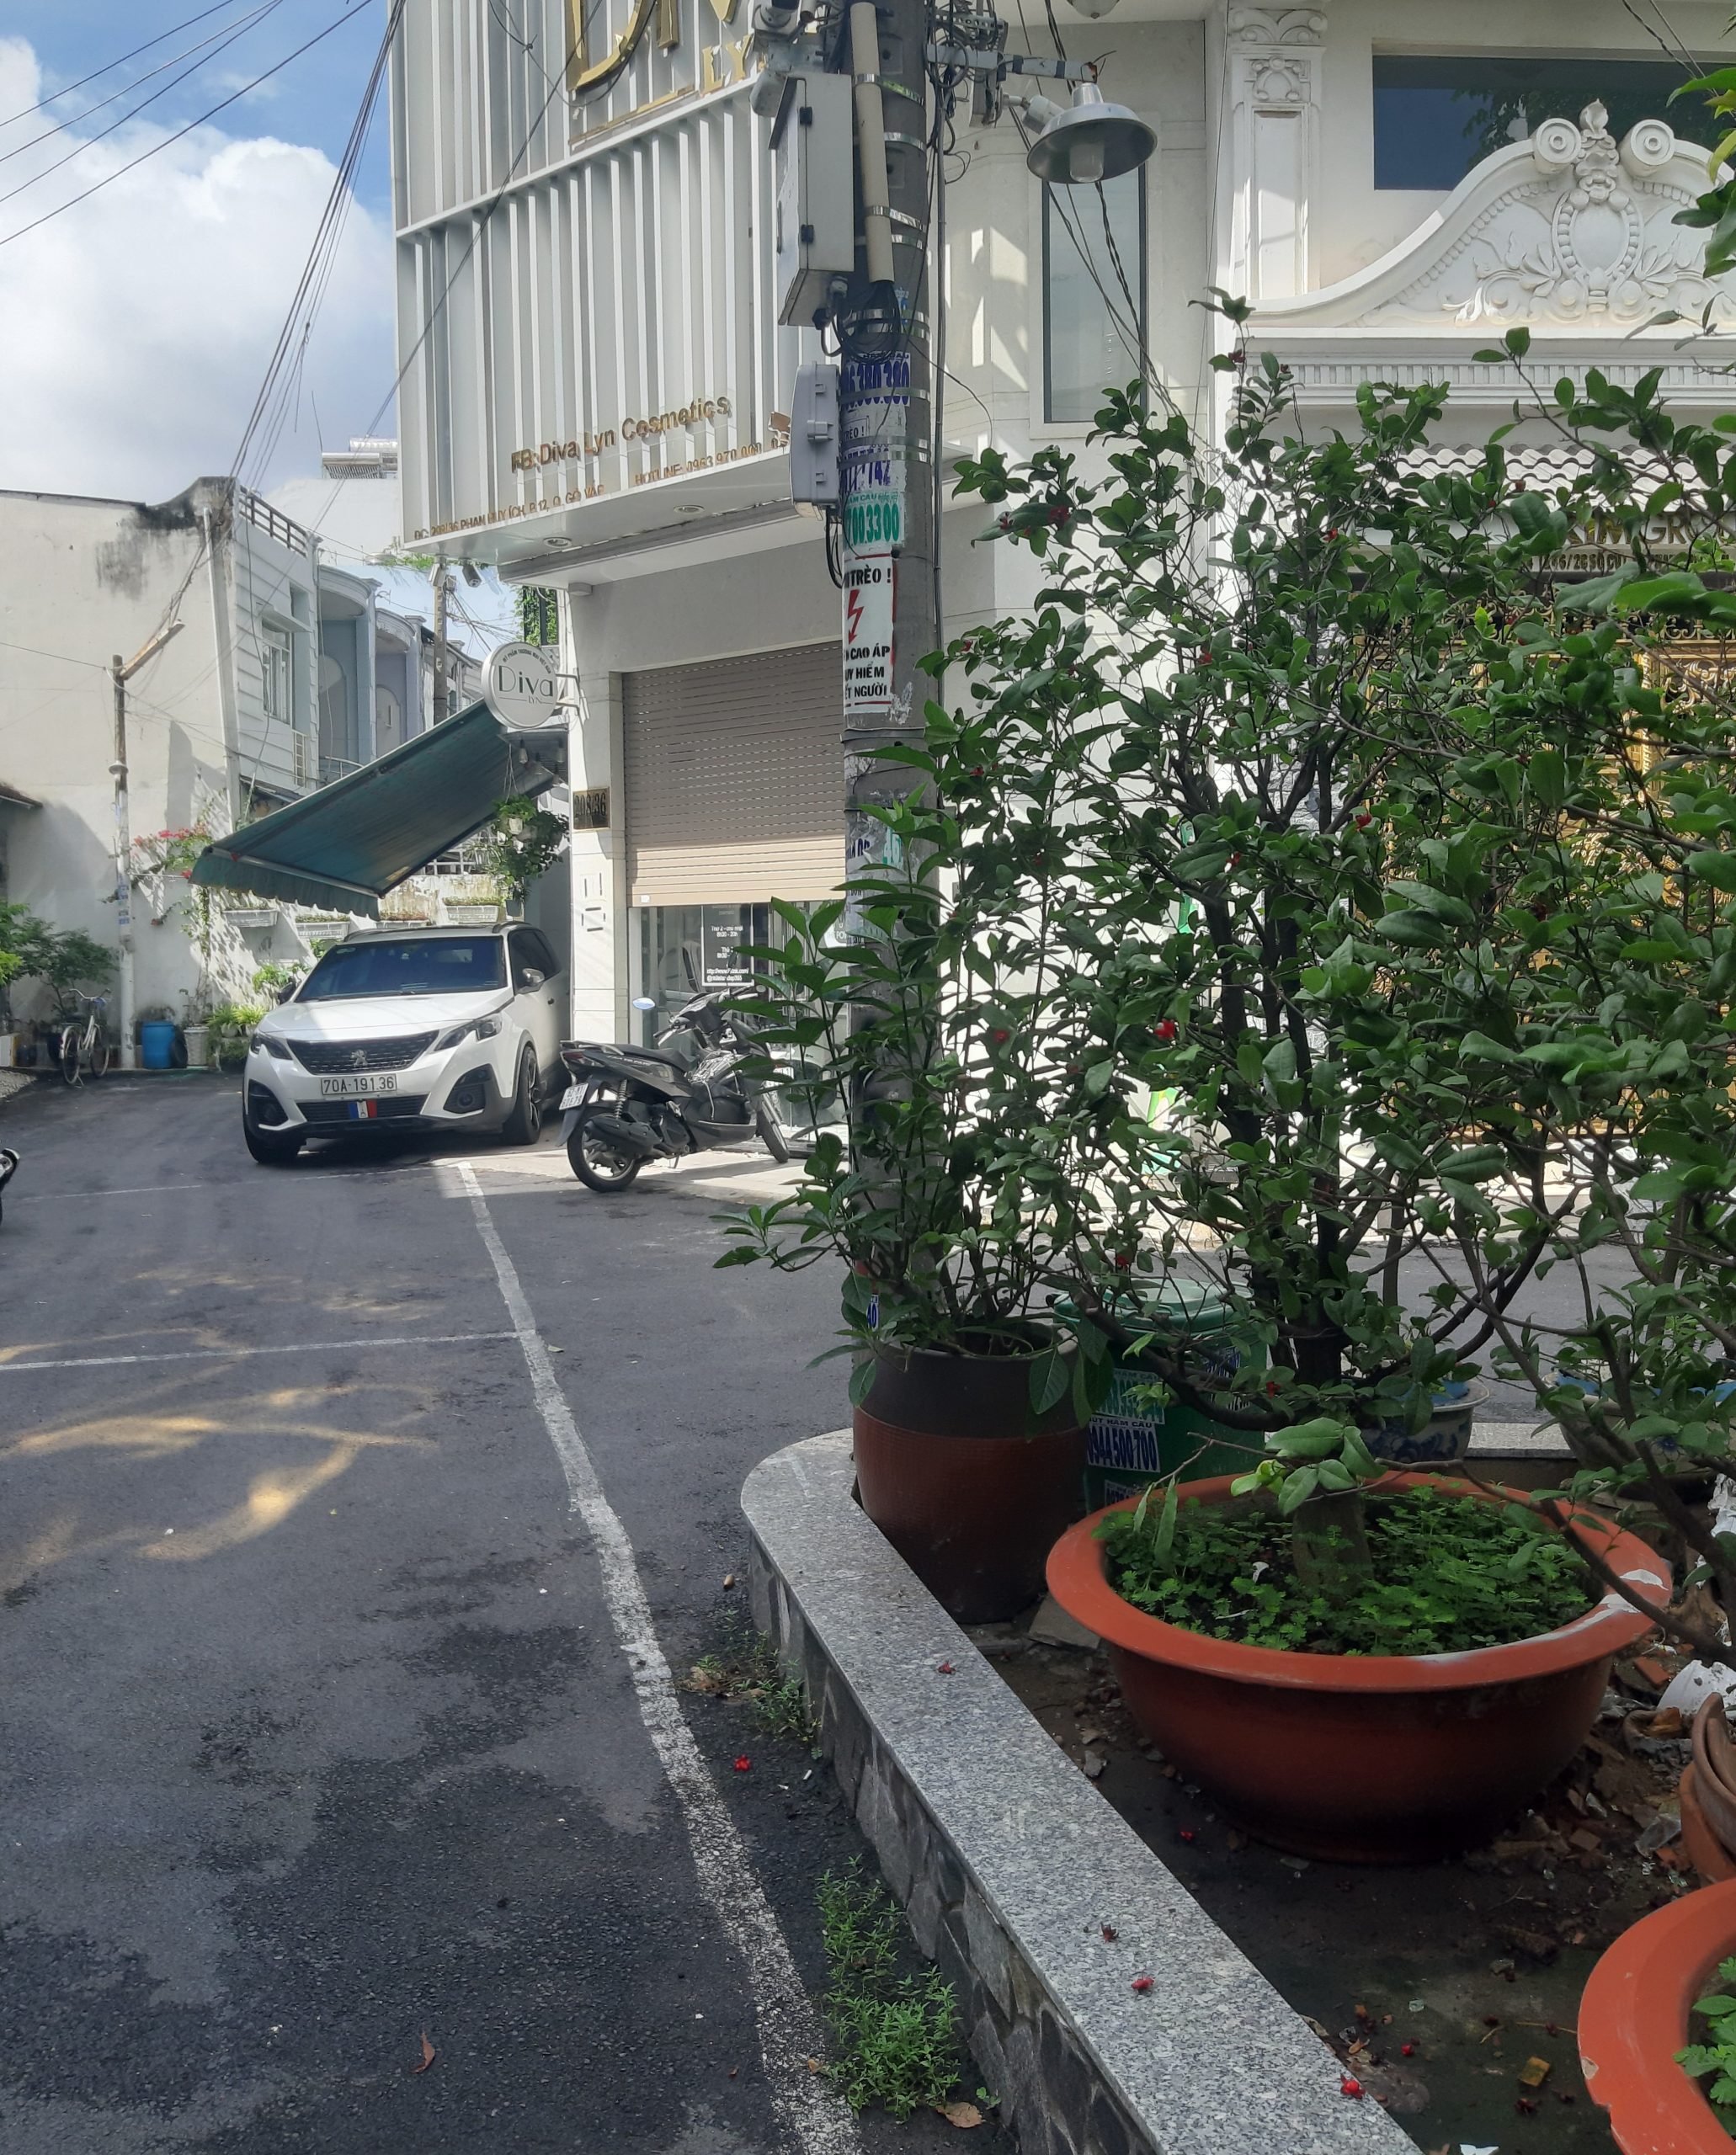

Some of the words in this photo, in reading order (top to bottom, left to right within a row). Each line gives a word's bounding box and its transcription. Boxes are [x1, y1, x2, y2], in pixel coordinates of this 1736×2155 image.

[584, 428, 616, 456] Lyn
[621, 396, 732, 442] Cosmetics
[461, 514, 486, 530] PHAN
[850, 646, 871, 661] CAO
[872, 642, 891, 657] ÁP
[855, 662, 885, 679] HIỂM
[498, 665, 553, 697] Diva
[854, 682, 887, 699] NGƯỜI
[323, 1077, 394, 1093] 70A-191.36
